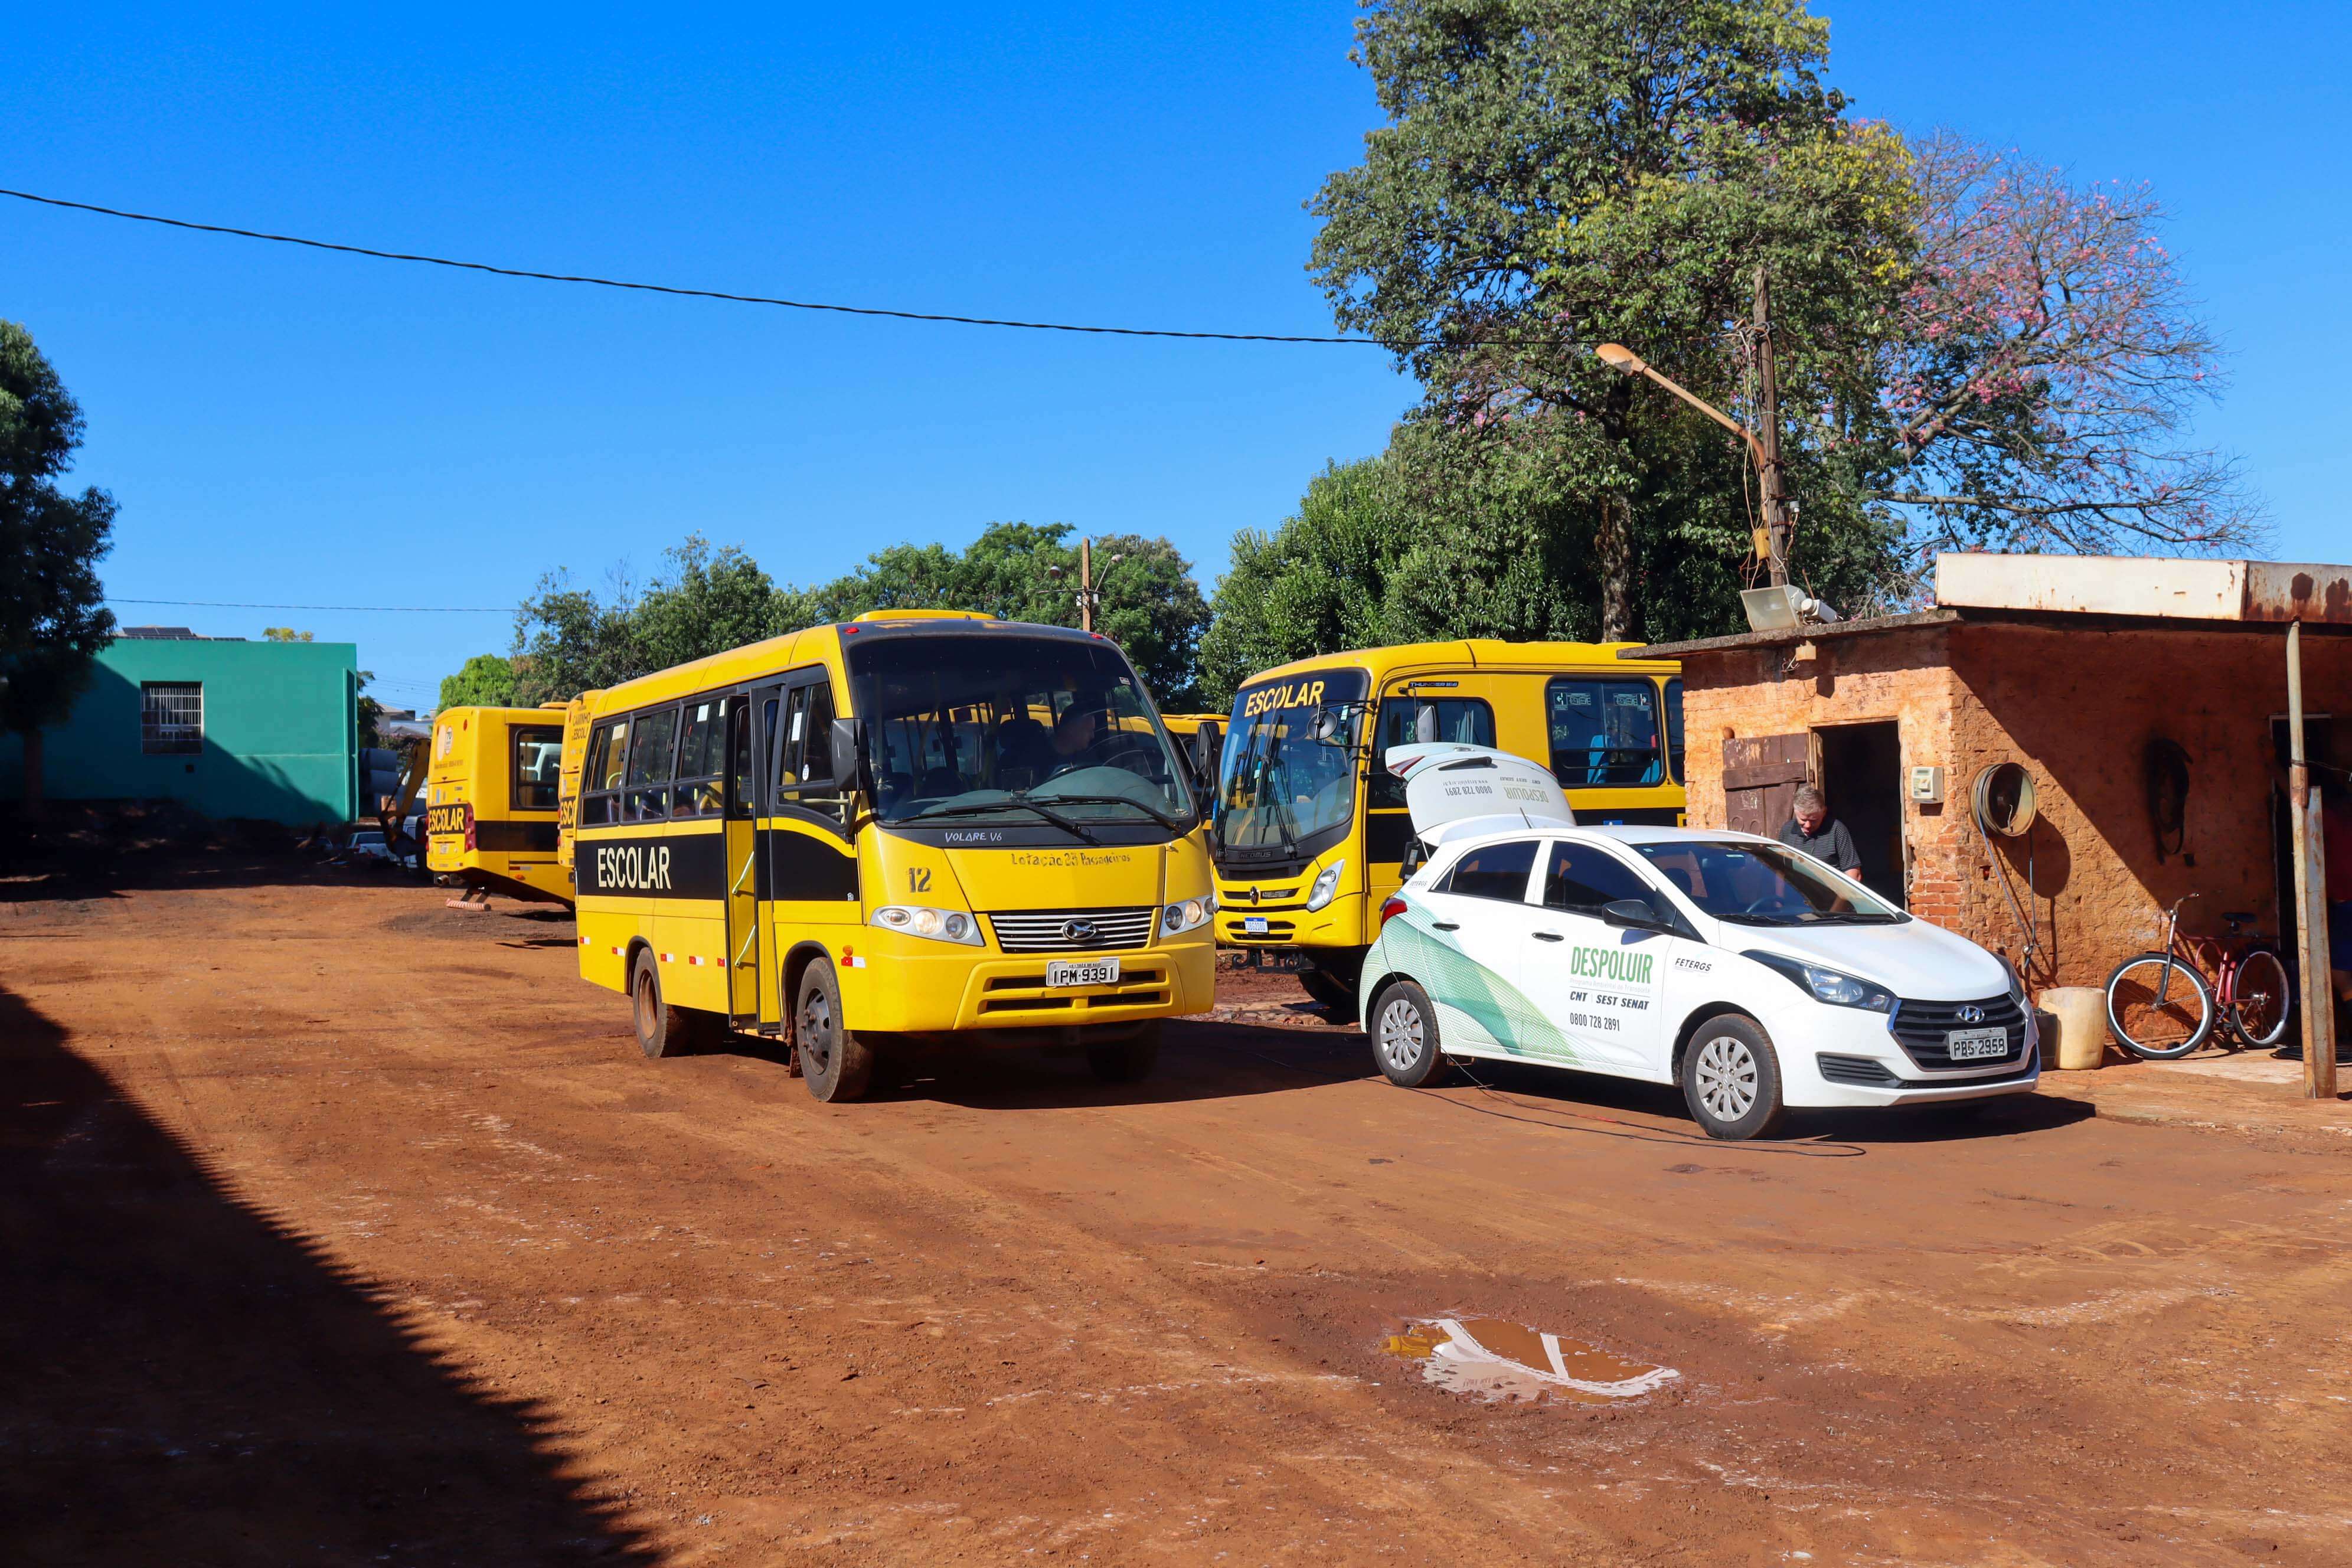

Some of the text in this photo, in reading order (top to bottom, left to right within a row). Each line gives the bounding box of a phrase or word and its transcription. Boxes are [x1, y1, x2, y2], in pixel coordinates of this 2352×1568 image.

[1244, 681, 1324, 717] ESCOLAR
[1445, 785, 1492, 796] 0800 728 2891
[1503, 786, 1549, 803] DESPOLUIR
[429, 808, 464, 831] ESCOLAR
[945, 832, 1002, 842] VOLARE V6
[597, 847, 671, 889] ESCOLAR
[909, 867, 931, 893] 12
[1570, 946, 1653, 984] DESPOLUIR
[1675, 958, 1711, 971] FETERGS
[1570, 991, 1649, 1010] CNT SEST SENAT
[1570, 1012, 1620, 1031] 0800 728 2891
